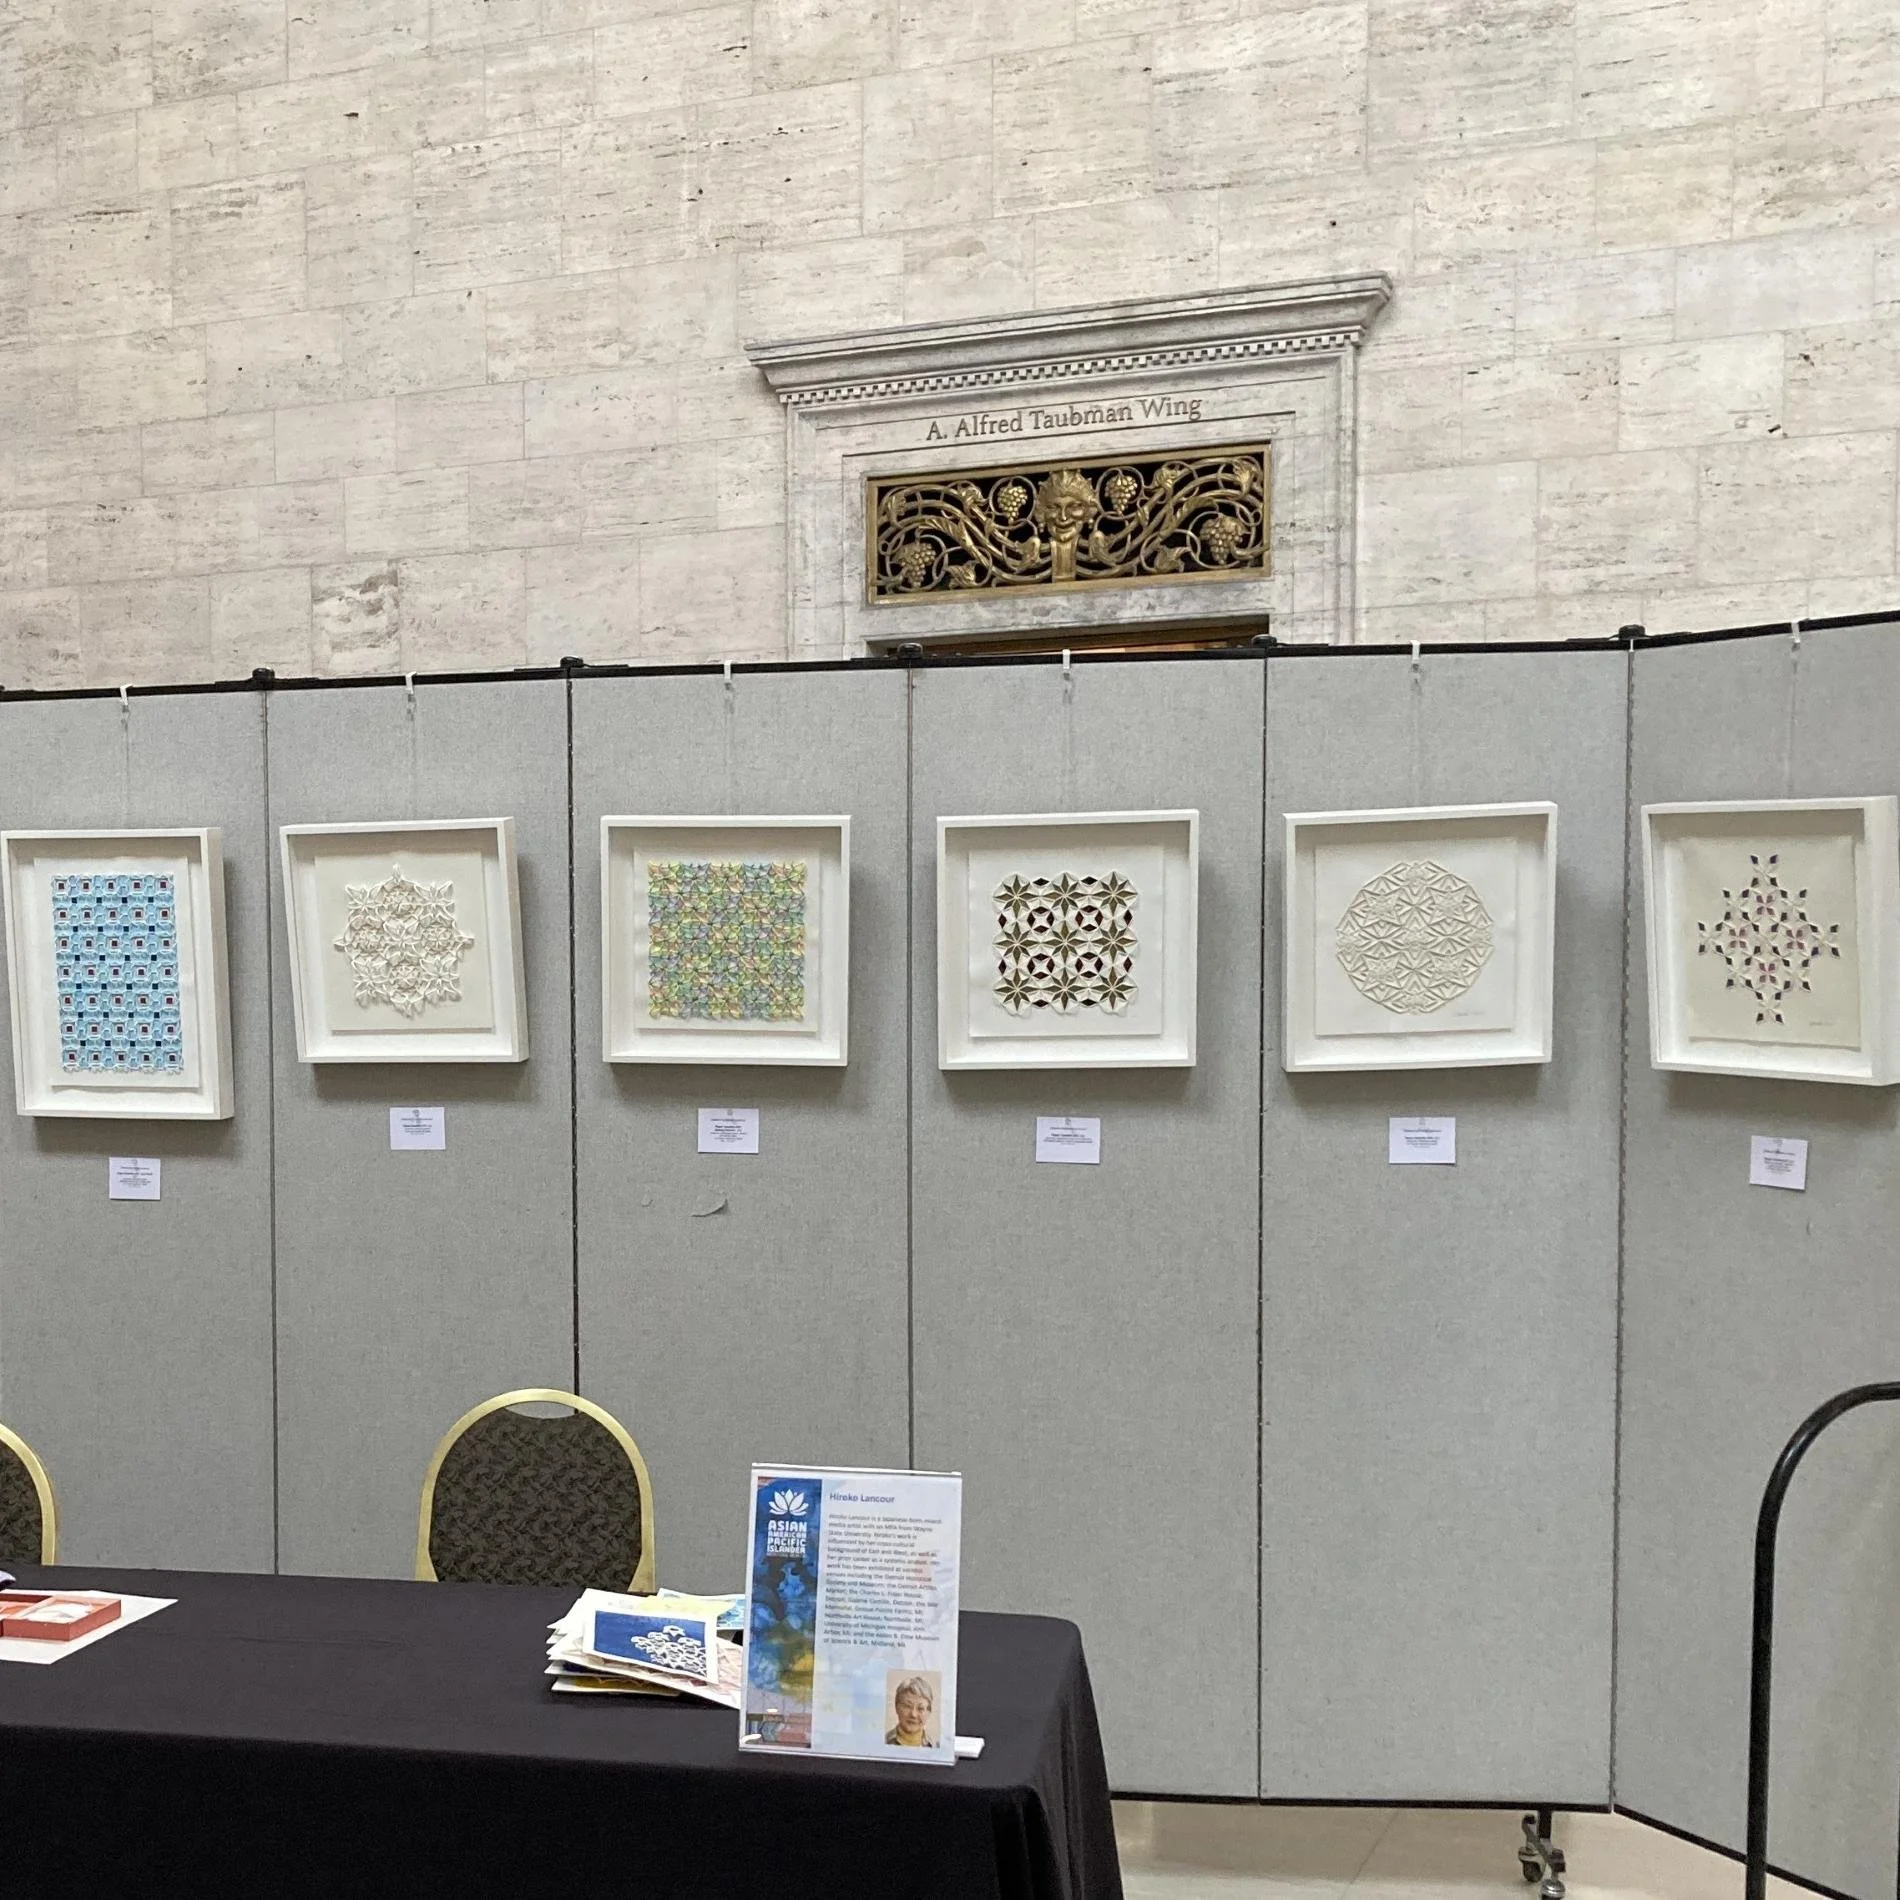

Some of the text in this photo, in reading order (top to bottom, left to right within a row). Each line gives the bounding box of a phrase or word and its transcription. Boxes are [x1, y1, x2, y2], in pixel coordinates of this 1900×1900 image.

[927, 397, 1203, 441] A. Alfred Taubman Wing
[829, 1493, 895, 1503] Hiroko Lancour
[768, 1520, 807, 1532] ASIAN
[768, 1537, 806, 1547] PACIFIC
[767, 1544, 805, 1554] ISLANDER
